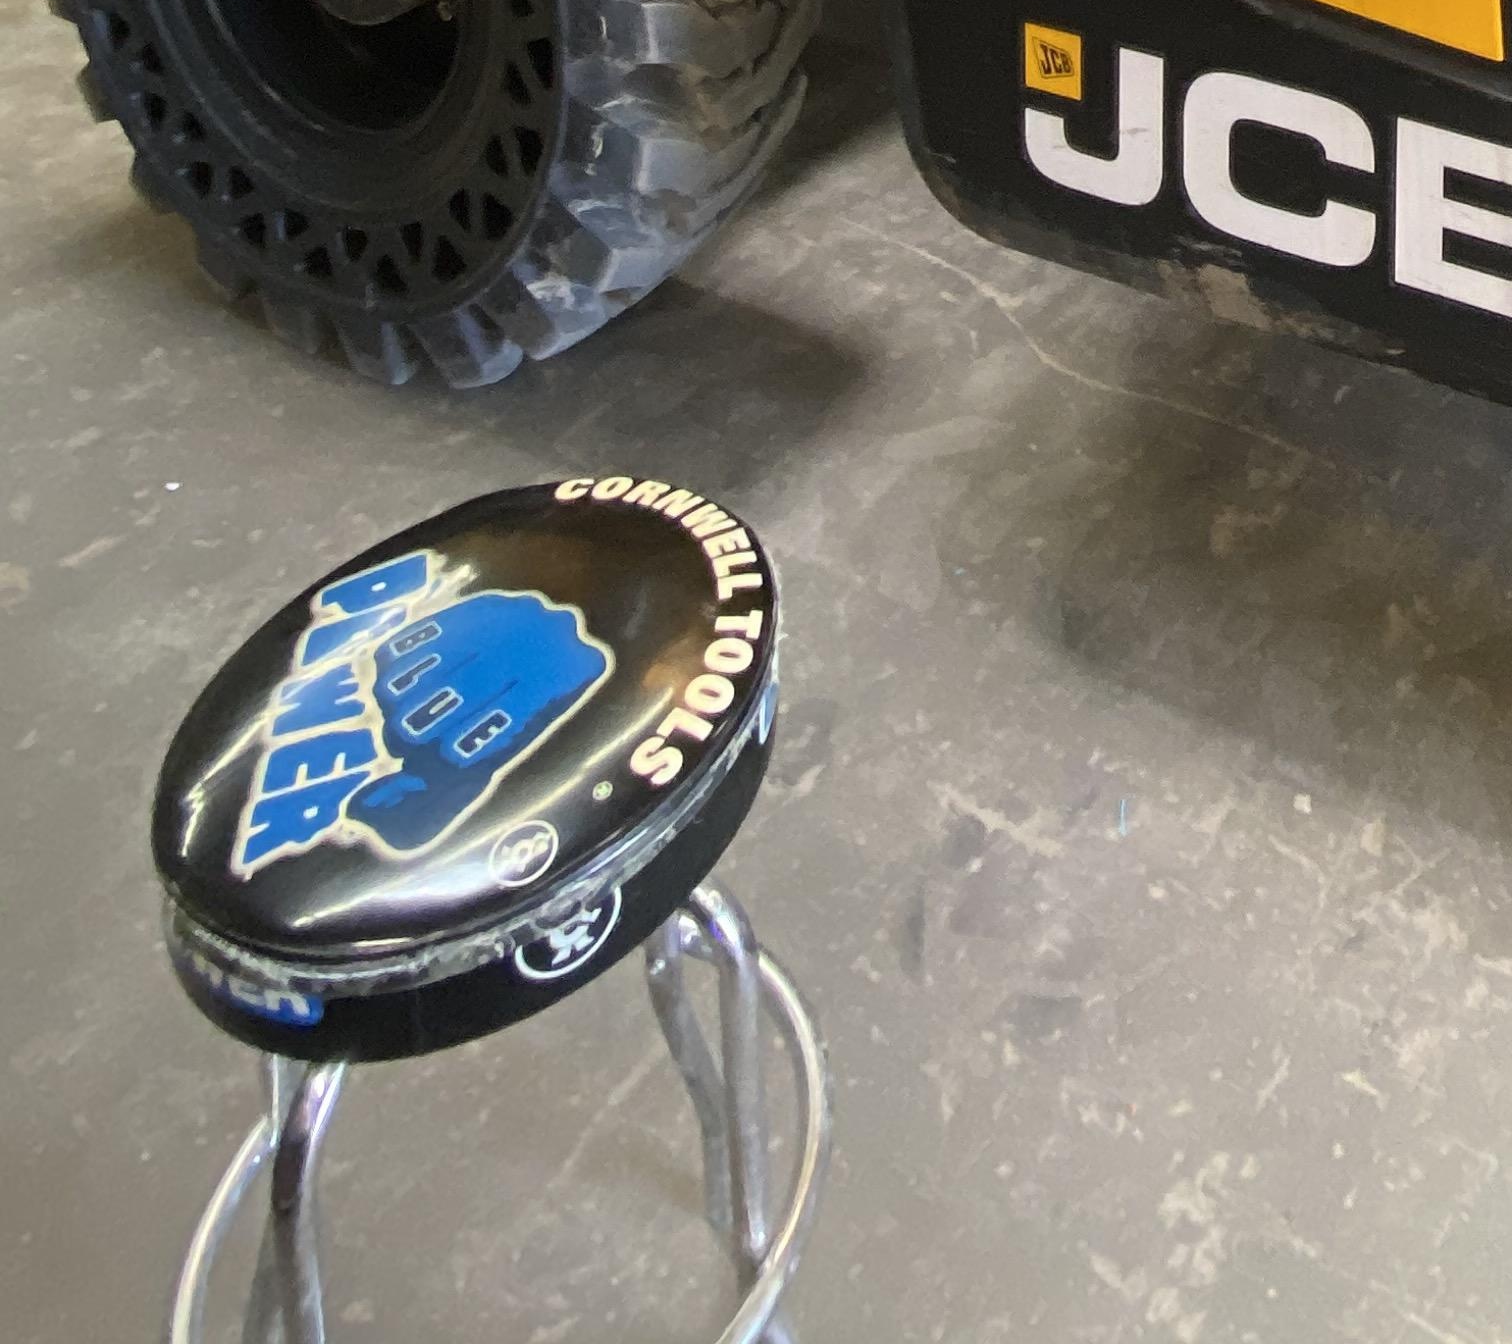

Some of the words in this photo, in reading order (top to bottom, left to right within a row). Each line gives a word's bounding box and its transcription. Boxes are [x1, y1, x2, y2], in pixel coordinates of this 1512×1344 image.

[1039, 43, 1072, 75] JCB
[554, 476, 763, 601] CORNWELL
[388, 620, 512, 758] BLUE
[630, 609, 763, 786] TOOLS
